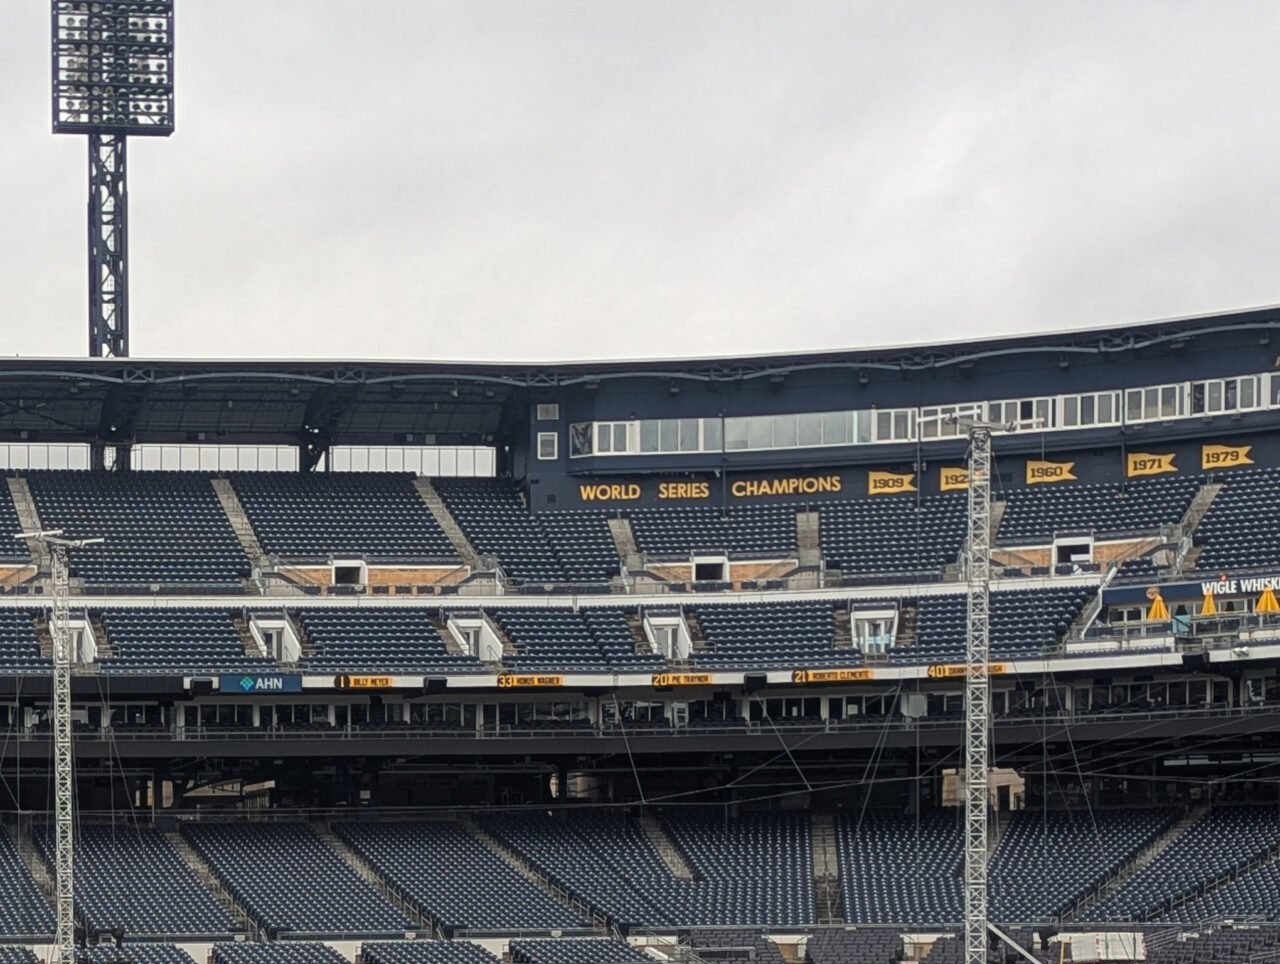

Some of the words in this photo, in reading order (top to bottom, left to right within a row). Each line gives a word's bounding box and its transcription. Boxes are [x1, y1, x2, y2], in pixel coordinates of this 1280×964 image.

[1204, 450, 1239, 464] 1979
[1131, 458, 1163, 471] 1971
[1030, 466, 1063, 478] 1960
[872, 477, 904, 489] 1909
[943, 474, 971, 486] 192
[579, 484, 640, 500] WORLD
[658, 482, 710, 498] SERIES
[731, 476, 841, 497] CHAMPIONS
[1201, 580, 1238, 596] WIGLE
[1240, 576, 1280, 593] WHISK
[795, 670, 806, 683] 21
[928, 665, 944, 678] 40
[255, 677, 283, 690] AHN
[499, 675, 513, 687] 33
[653, 674, 668, 686] 20
